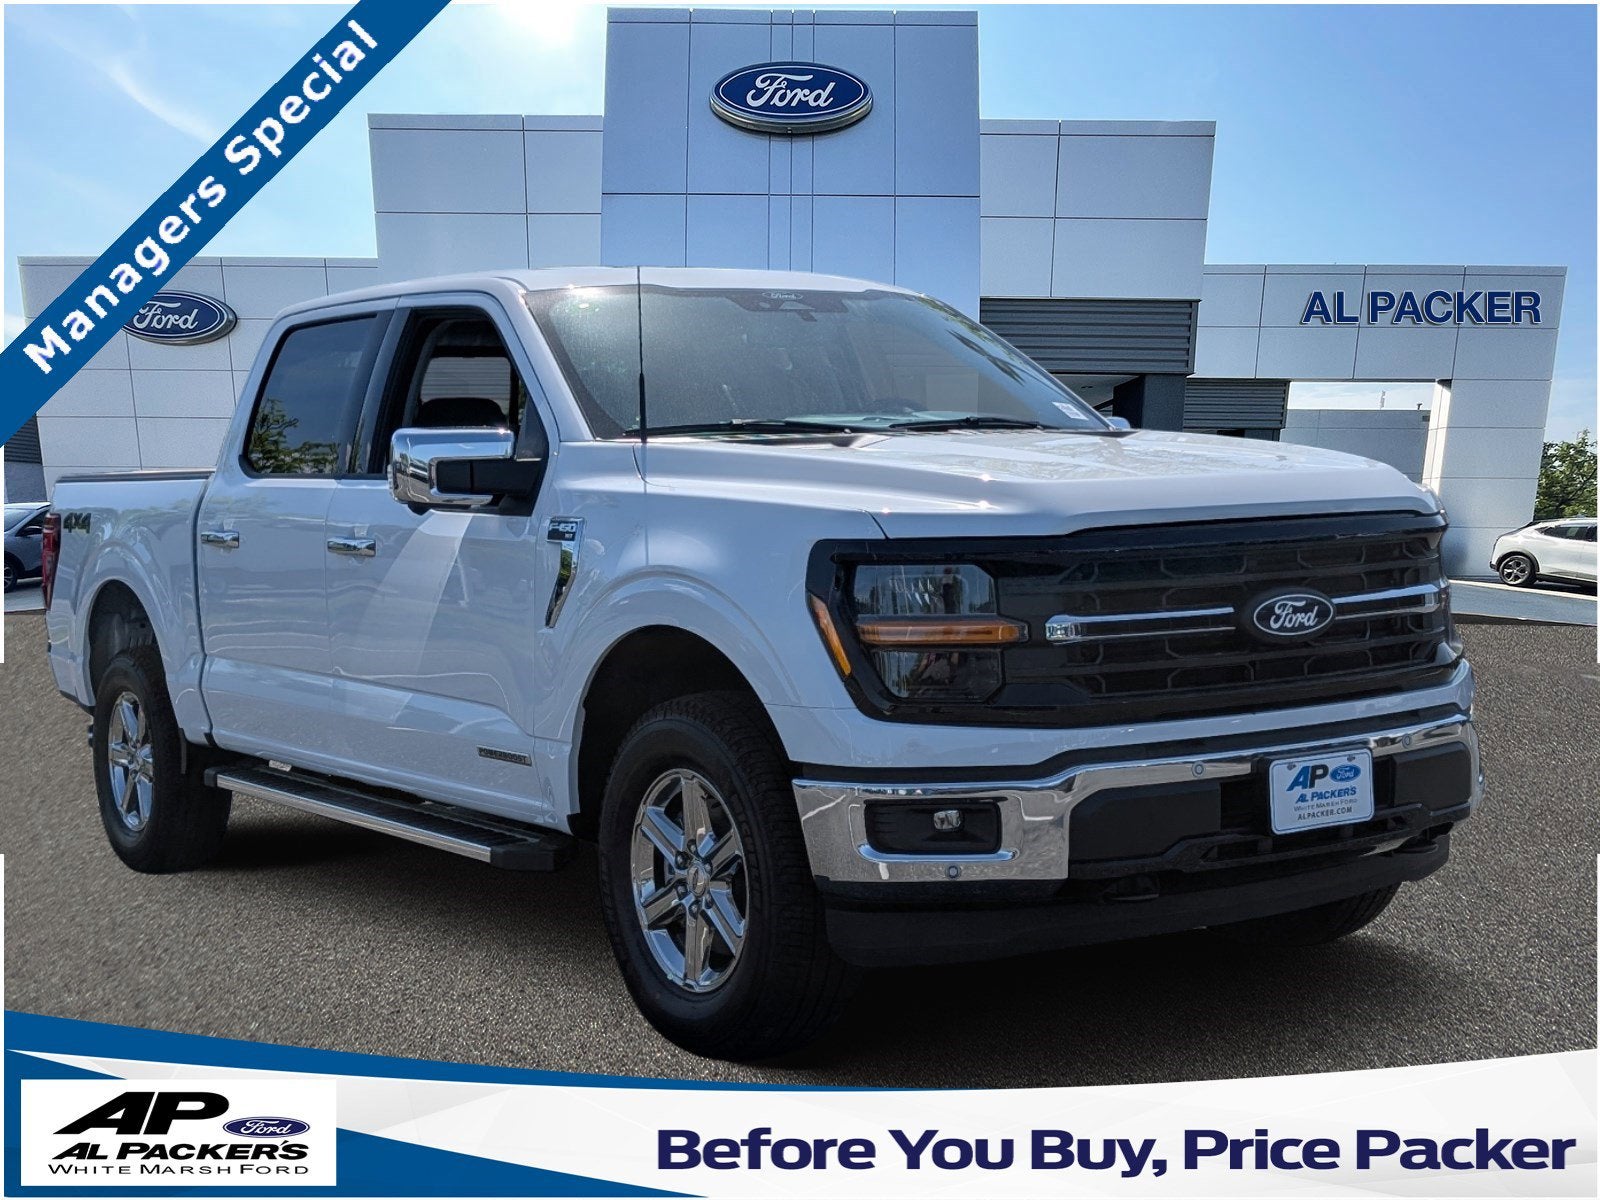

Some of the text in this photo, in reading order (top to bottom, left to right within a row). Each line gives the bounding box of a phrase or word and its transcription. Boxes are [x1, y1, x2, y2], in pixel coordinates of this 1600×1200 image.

[746, 73, 836, 107] Ford
[133, 301, 199, 329] Ford
[1302, 290, 1542, 324] AL PACKER
[1270, 600, 1319, 629] Ford
[1286, 764, 1355, 791] AP Ford
[1295, 785, 1357, 804] AL PACKER'S
[1297, 806, 1353, 821] ALPACKER.COM
